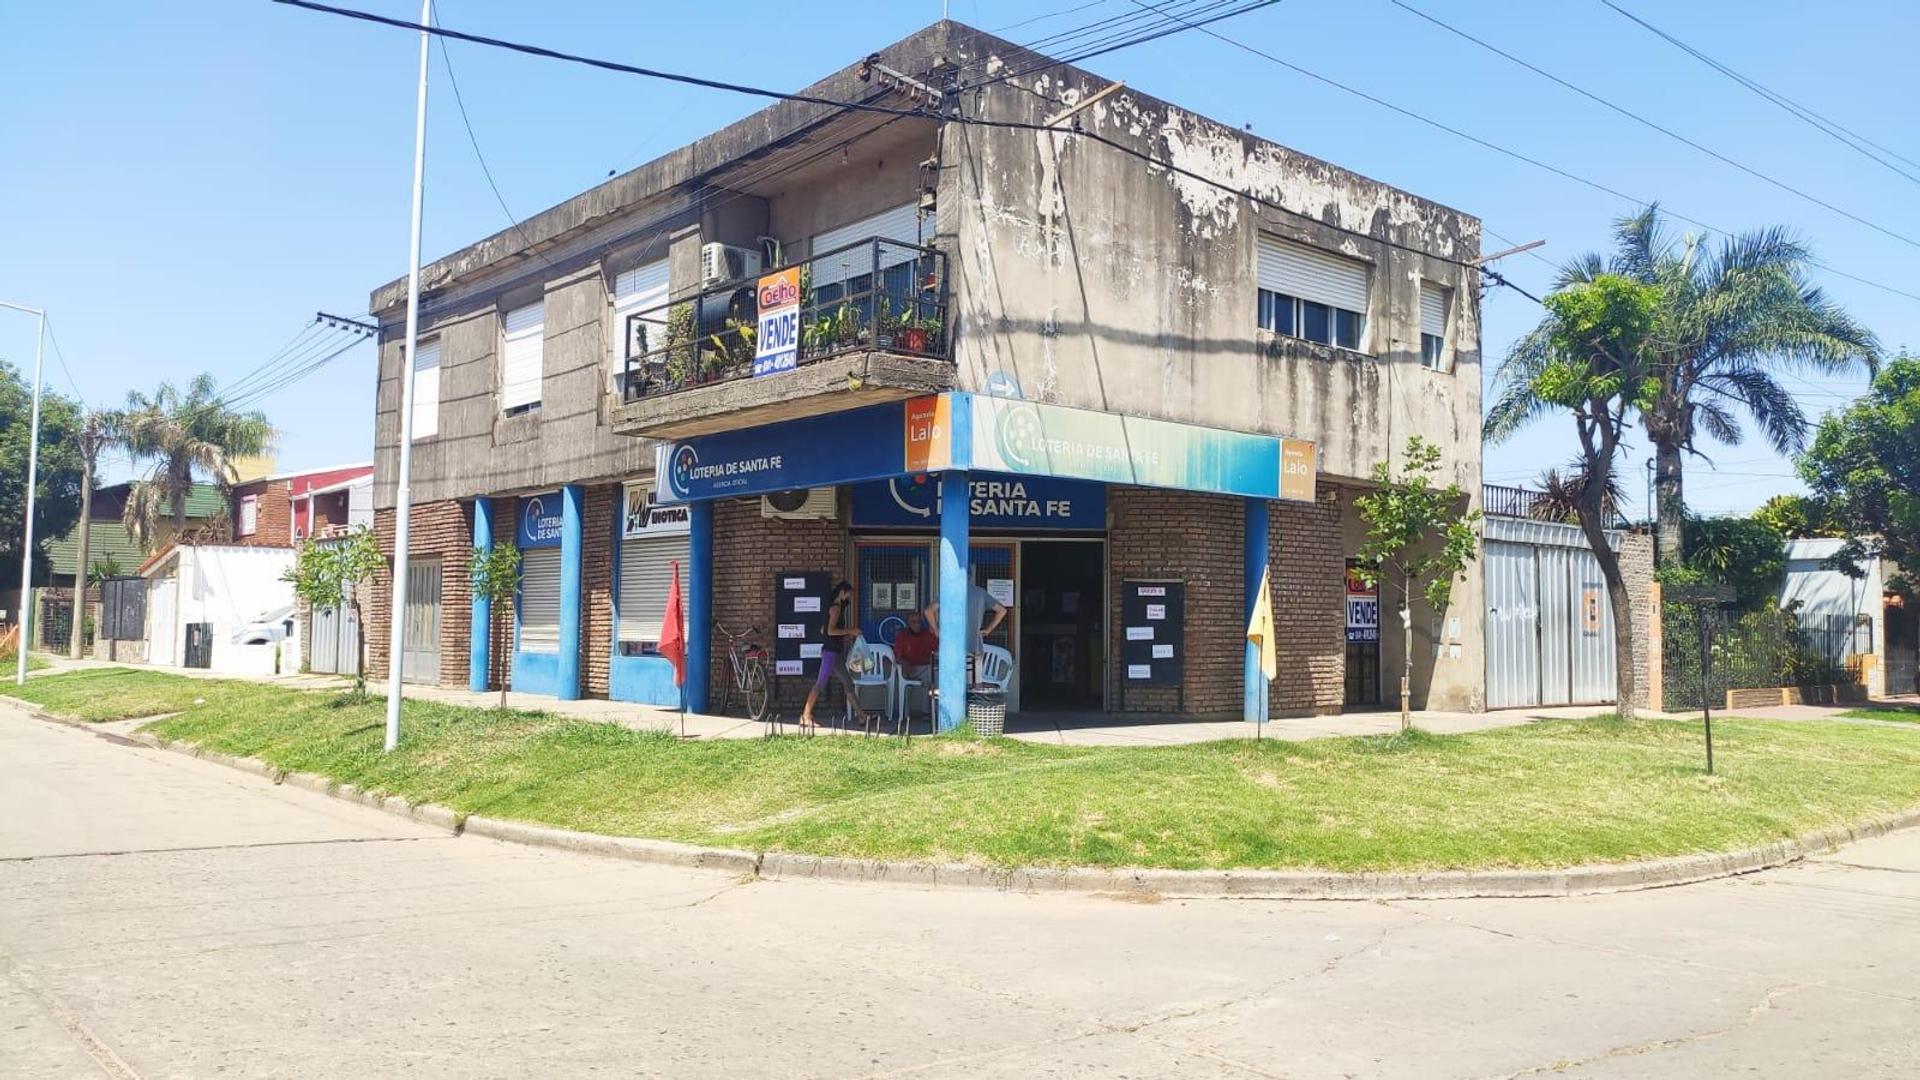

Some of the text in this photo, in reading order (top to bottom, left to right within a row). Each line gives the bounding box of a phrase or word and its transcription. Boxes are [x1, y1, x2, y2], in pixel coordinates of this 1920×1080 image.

[760, 283, 796, 309] Coelho
[760, 312, 797, 352] VENDE
[911, 421, 940, 442] Lalo
[1032, 437, 1084, 454] LOTERIA
[1087, 443, 1102, 459] DE
[1145, 450, 1159, 465] FE
[690, 456, 782, 480] LOTERIA DE SANTA FE
[1284, 457, 1308, 476] Lalo
[970, 500, 1071, 517] SANTA FE
[1348, 601, 1377, 624] VENDE
